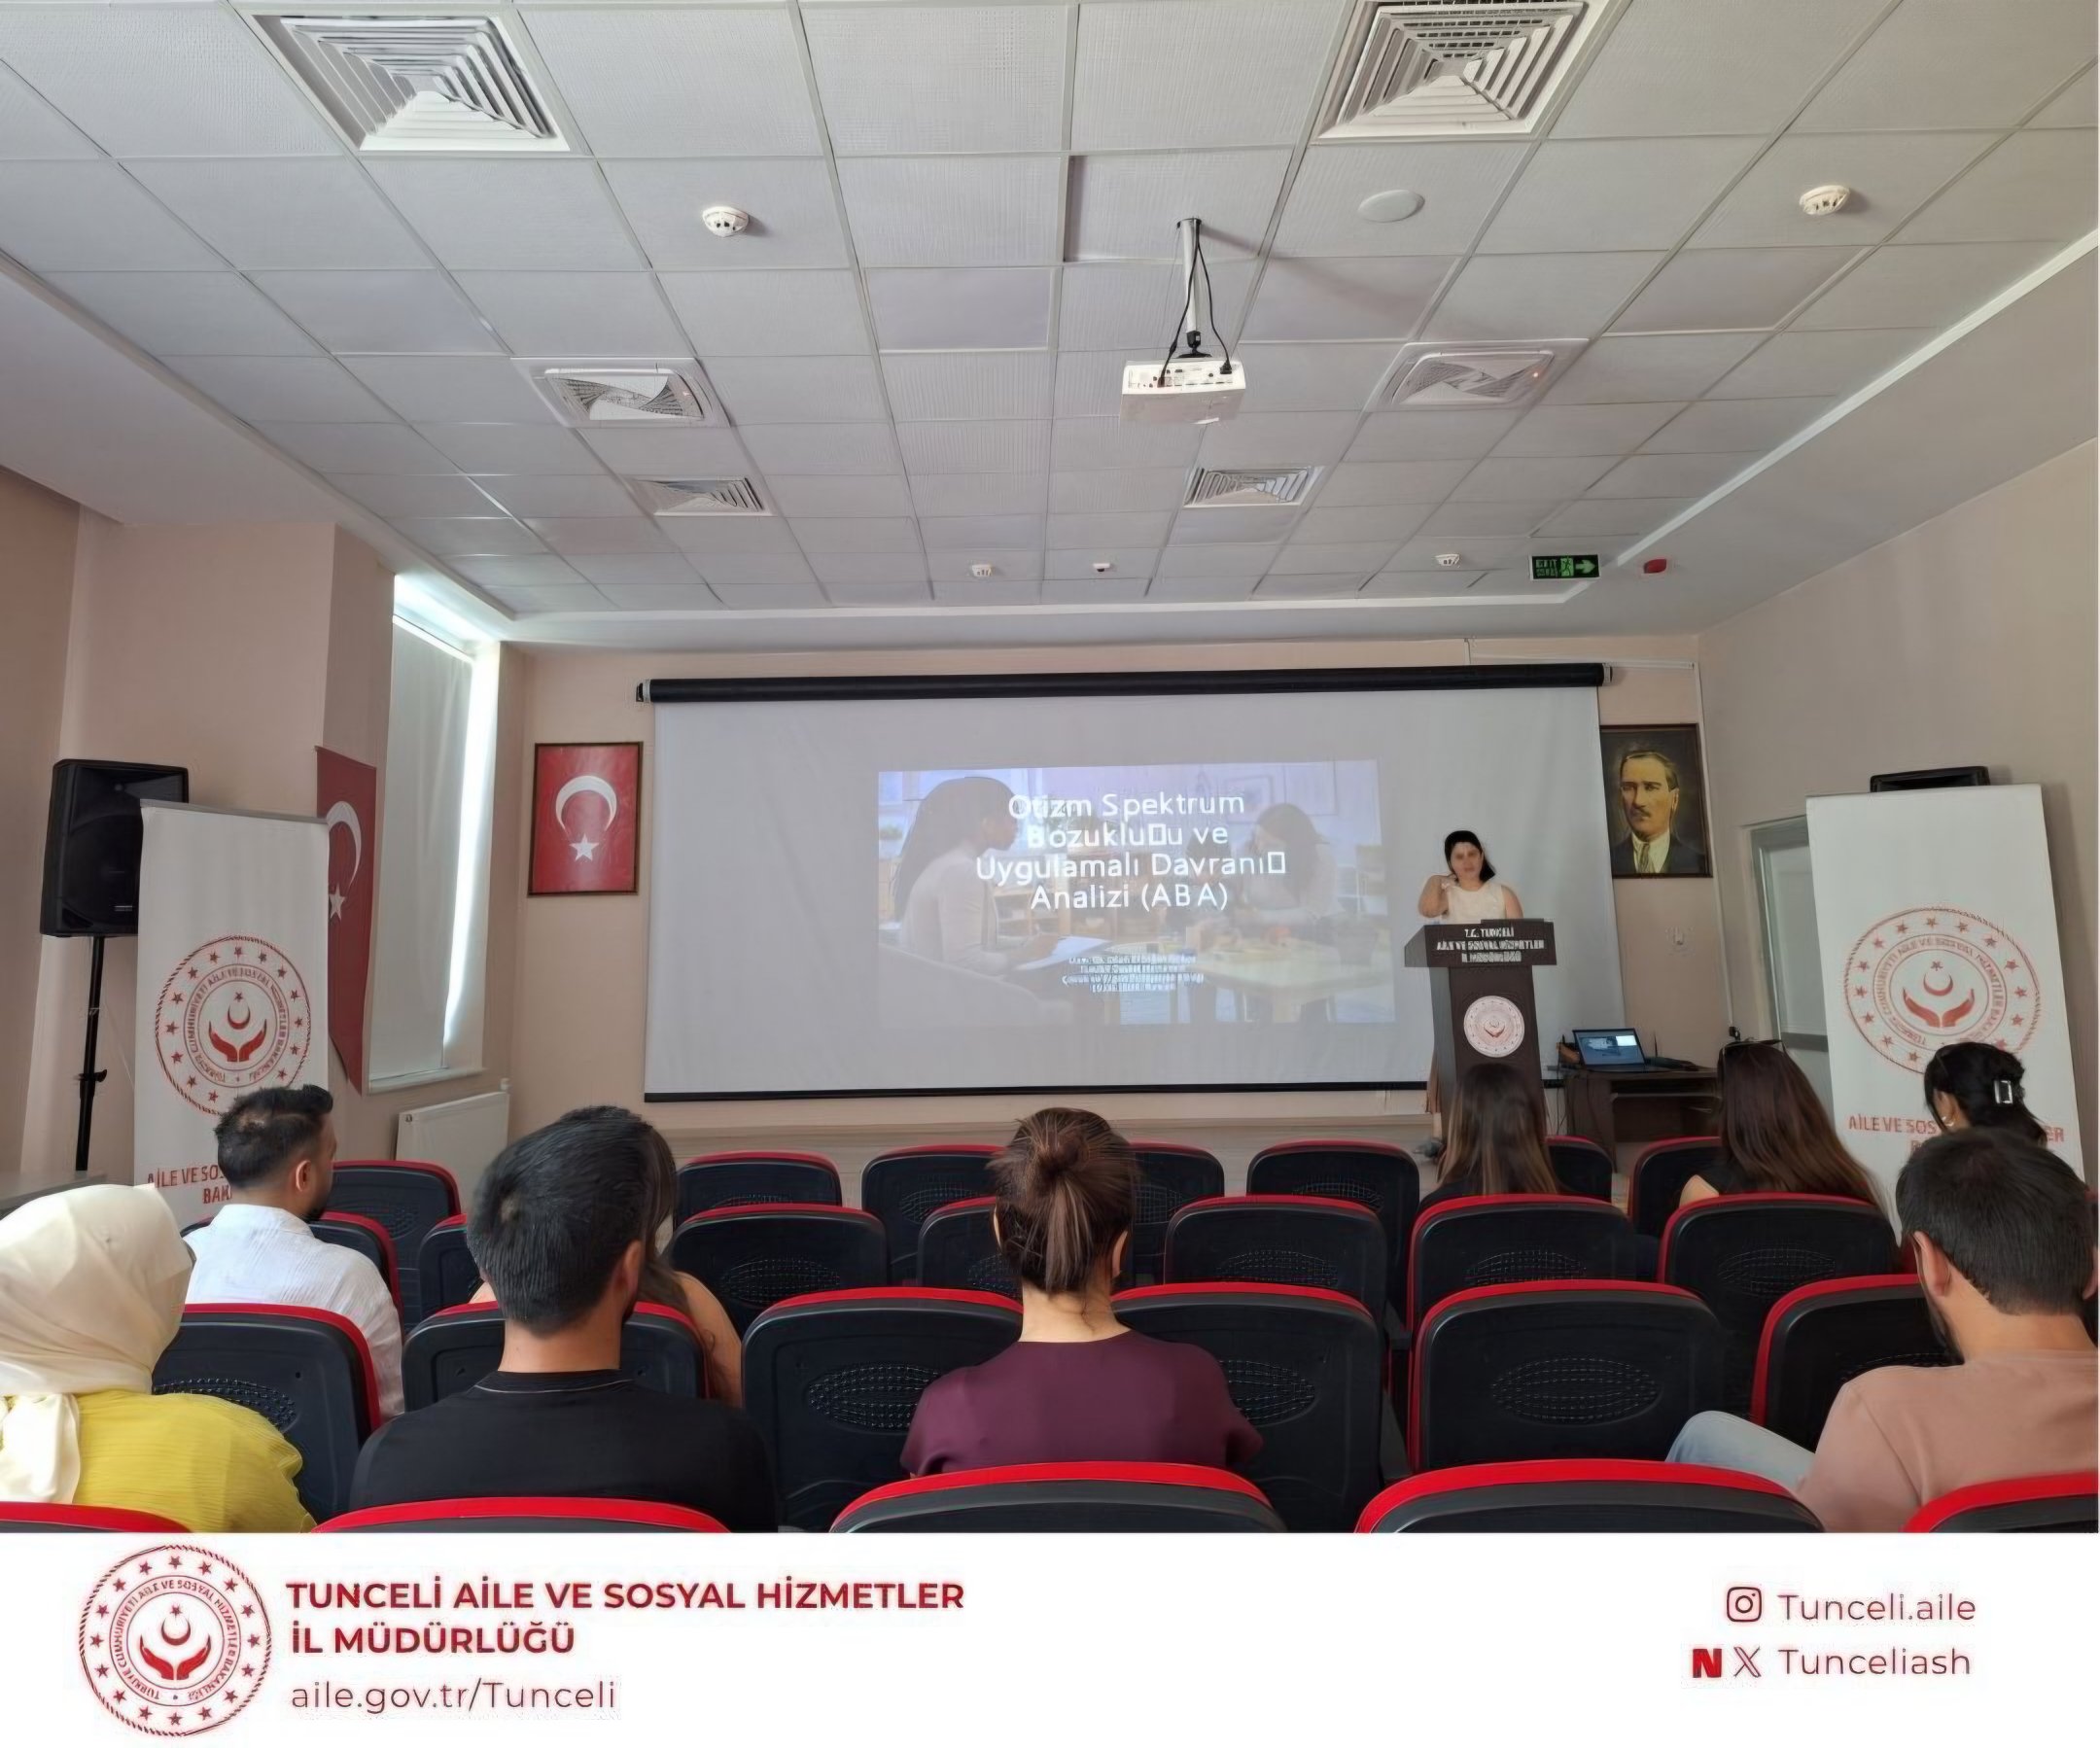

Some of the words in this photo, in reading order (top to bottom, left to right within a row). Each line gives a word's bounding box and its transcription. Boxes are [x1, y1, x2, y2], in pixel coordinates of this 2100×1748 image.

[1008, 794, 1092, 820] Otizm
[1102, 791, 1244, 822] Spektrum
[1193, 826, 1229, 845] ve
[976, 853, 1139, 887] Uygulamalı
[1031, 884, 1130, 910] Analizi
[1140, 883, 1228, 912] (ABA)
[1906, 1119, 1938, 1136] SOS
